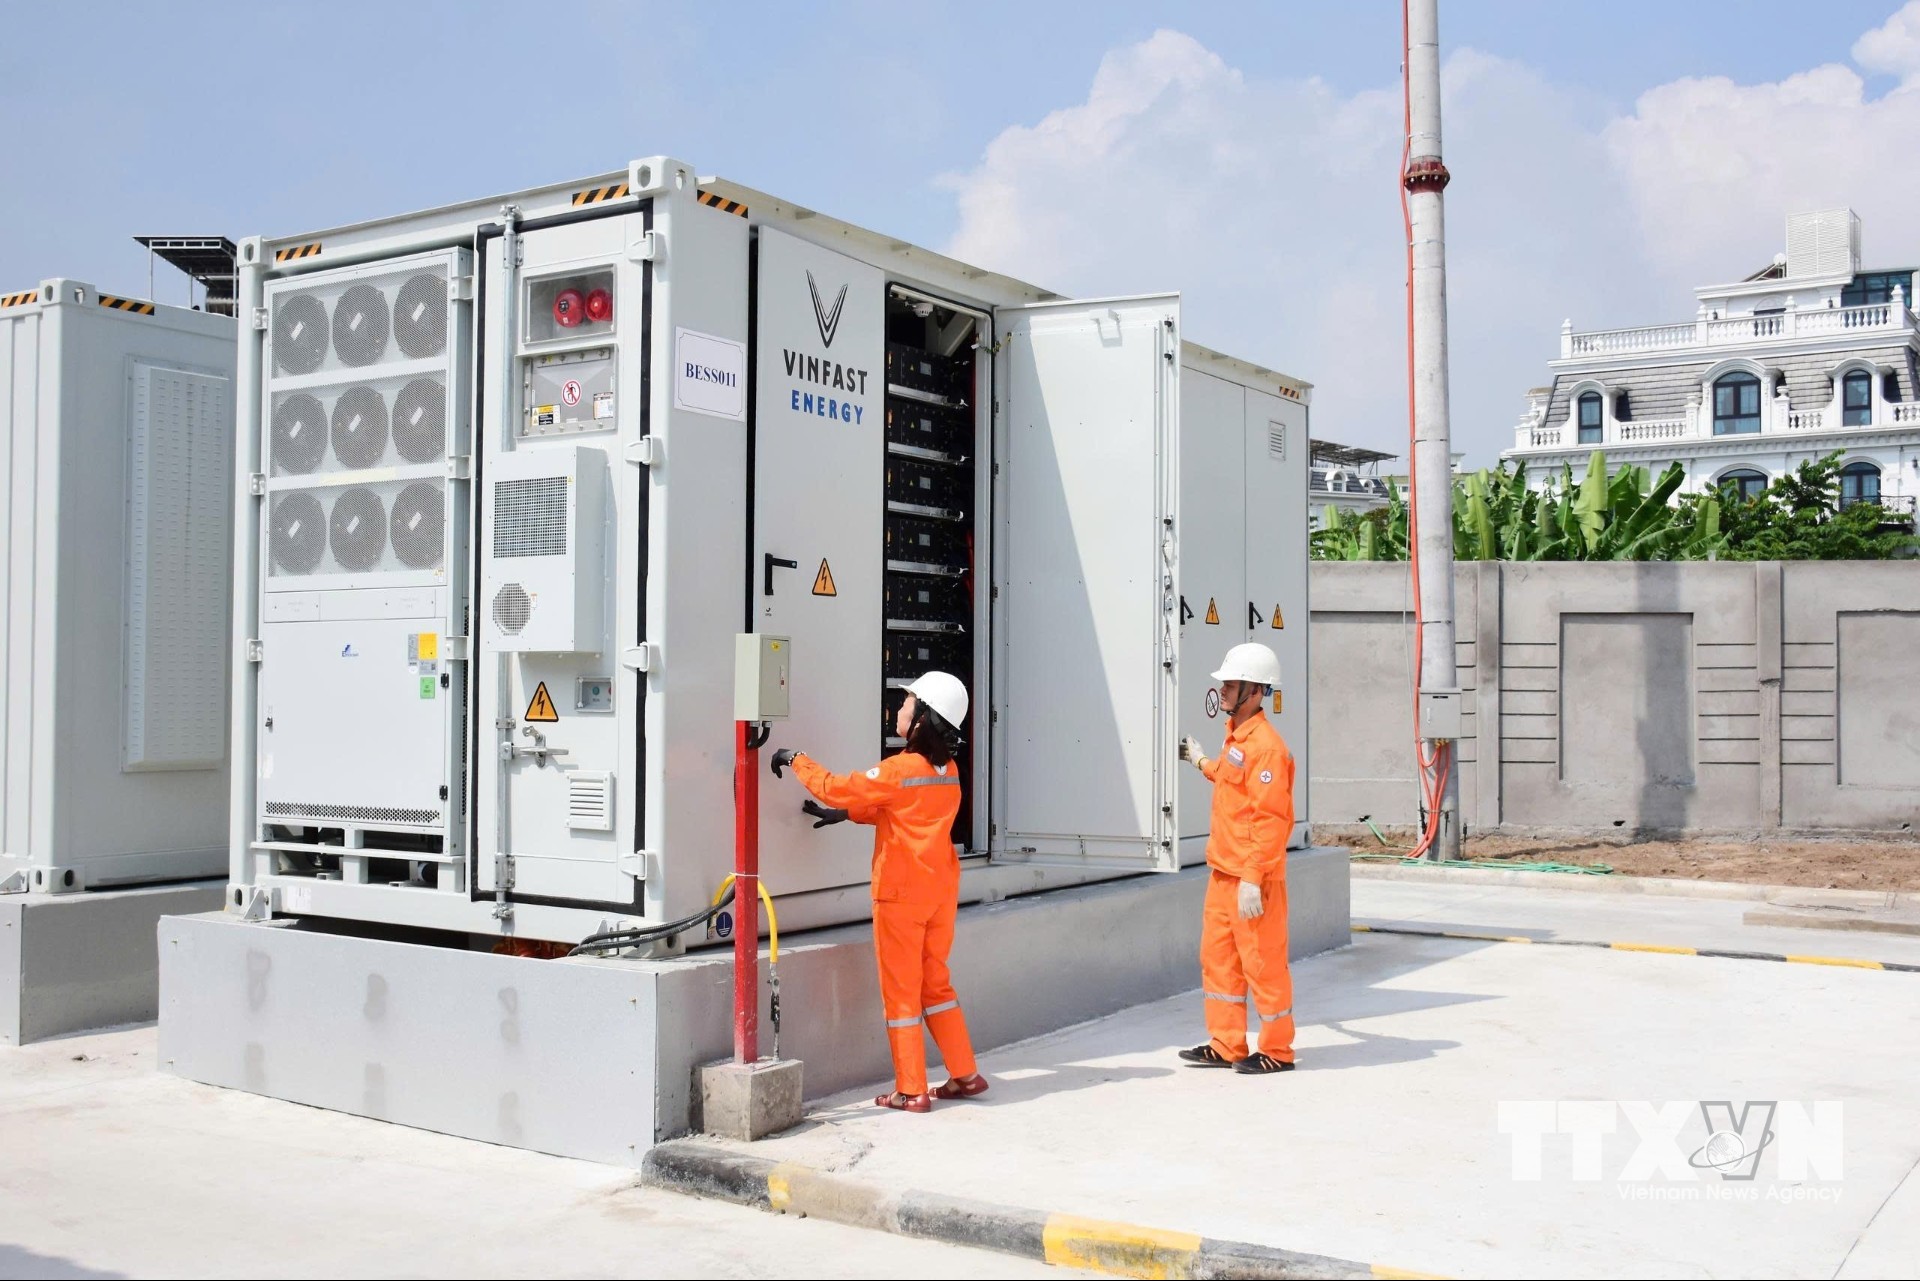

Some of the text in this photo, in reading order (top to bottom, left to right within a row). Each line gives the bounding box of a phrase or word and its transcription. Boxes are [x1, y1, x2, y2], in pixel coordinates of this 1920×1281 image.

[685, 361, 737, 388] BESS011
[783, 349, 868, 395] VINFAST
[791, 389, 863, 425] ENERGY
